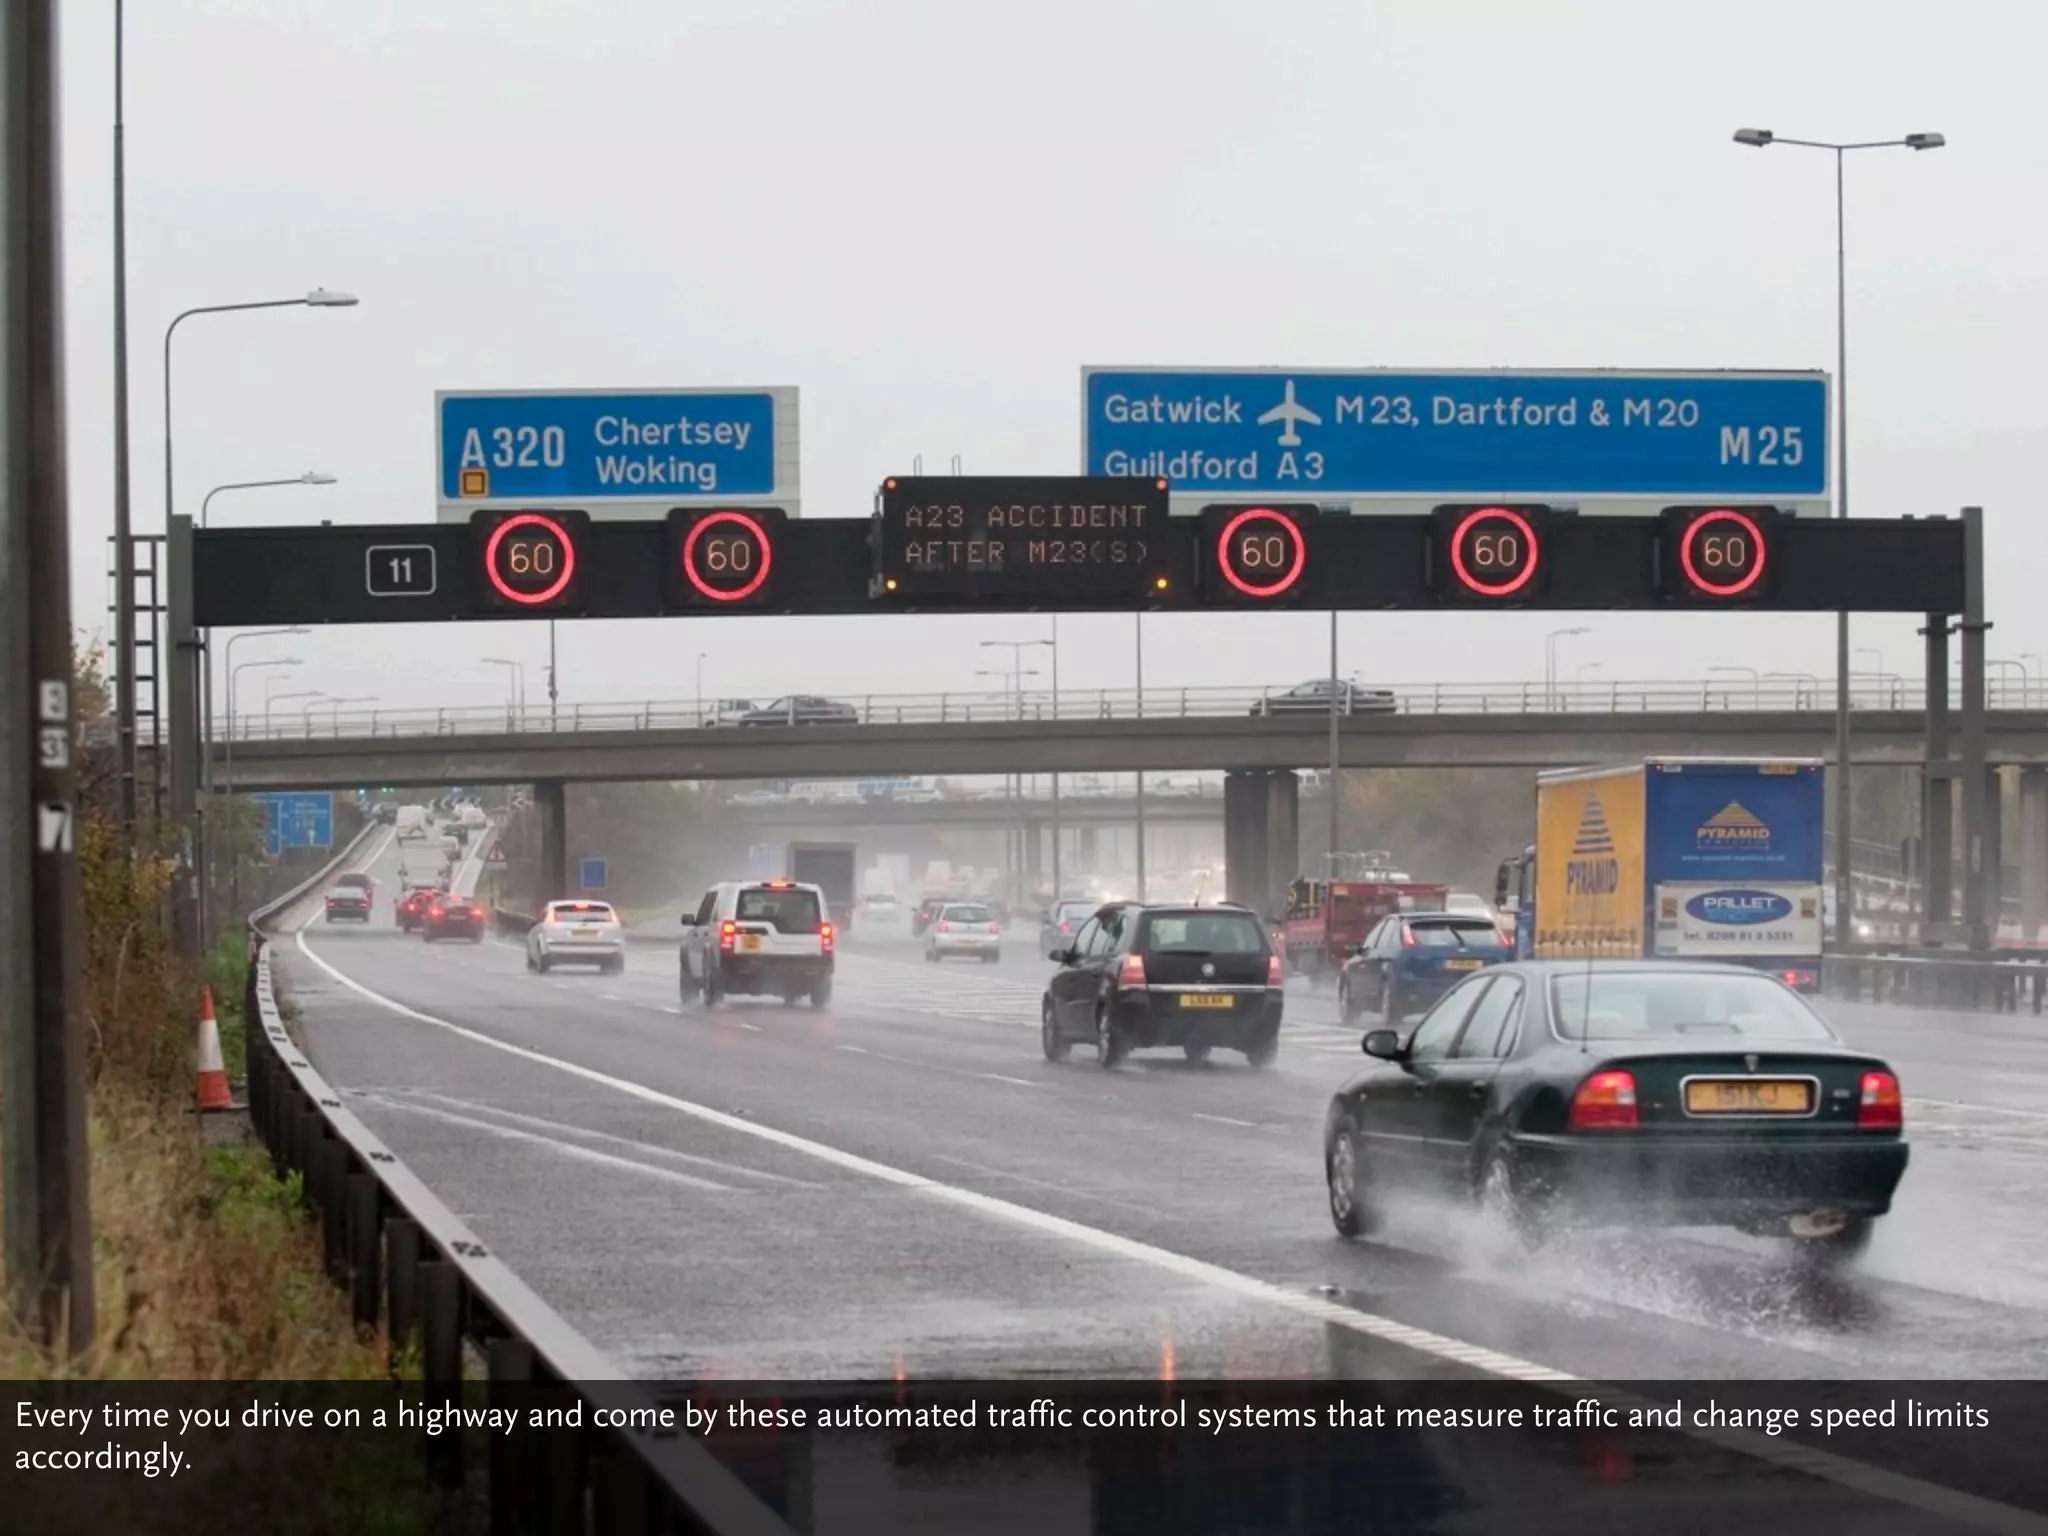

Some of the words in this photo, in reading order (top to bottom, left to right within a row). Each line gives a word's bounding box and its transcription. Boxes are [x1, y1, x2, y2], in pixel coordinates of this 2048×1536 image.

[1104, 394, 1243, 424] Gatwick
[1335, 395, 1419, 427] M23,
[1432, 396, 1576, 425] Dartford
[1589, 400, 1609, 426] &
[1623, 398, 1699, 427] M20
[460, 426, 566, 468] A320
[594, 415, 752, 449] Chertsey
[1720, 426, 1803, 465] M25
[594, 455, 717, 490] Woking
[1104, 451, 1258, 479] Guildford
[1276, 452, 1325, 480] A3
[904, 505, 964, 528] A23
[987, 505, 1148, 528] ACCIDENT
[511, 542, 553, 574] 60
[707, 539, 750, 571] 60
[904, 541, 1006, 564] AFTER
[1028, 541, 1148, 564] M23(S)
[1241, 537, 1285, 567] 60
[1474, 535, 1518, 566] 60
[1704, 537, 1745, 567] 60
[388, 557, 412, 583] 11
[1697, 827, 1771, 839] PYRAMID
[1566, 858, 1618, 895] PYRAMID
[1703, 896, 1778, 909] PALLET
